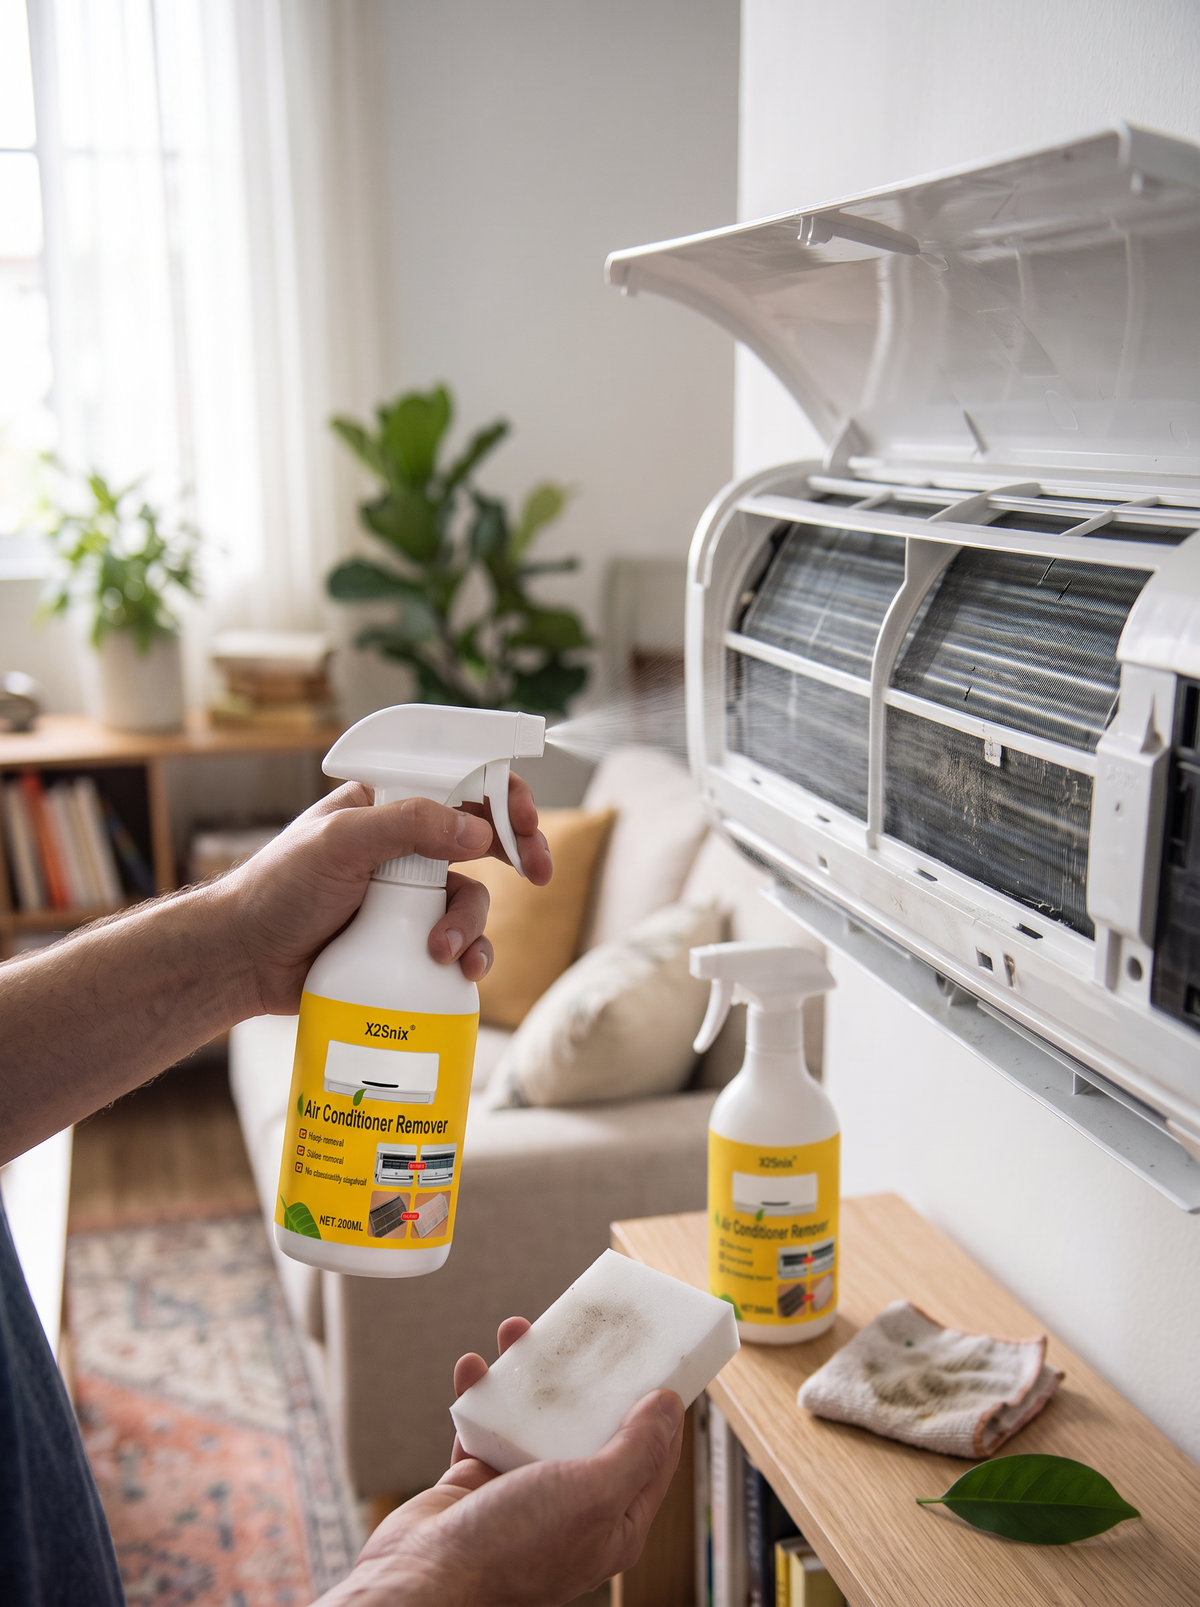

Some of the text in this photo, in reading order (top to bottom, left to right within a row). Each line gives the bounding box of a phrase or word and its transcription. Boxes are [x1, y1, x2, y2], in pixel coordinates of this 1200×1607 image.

[304, 1099, 449, 1135] Air Conditioner Remover
[319, 1214, 364, 1232] NET.200ML
[733, 1219, 789, 1240] Conditioner
[791, 1219, 829, 1239] Remover
